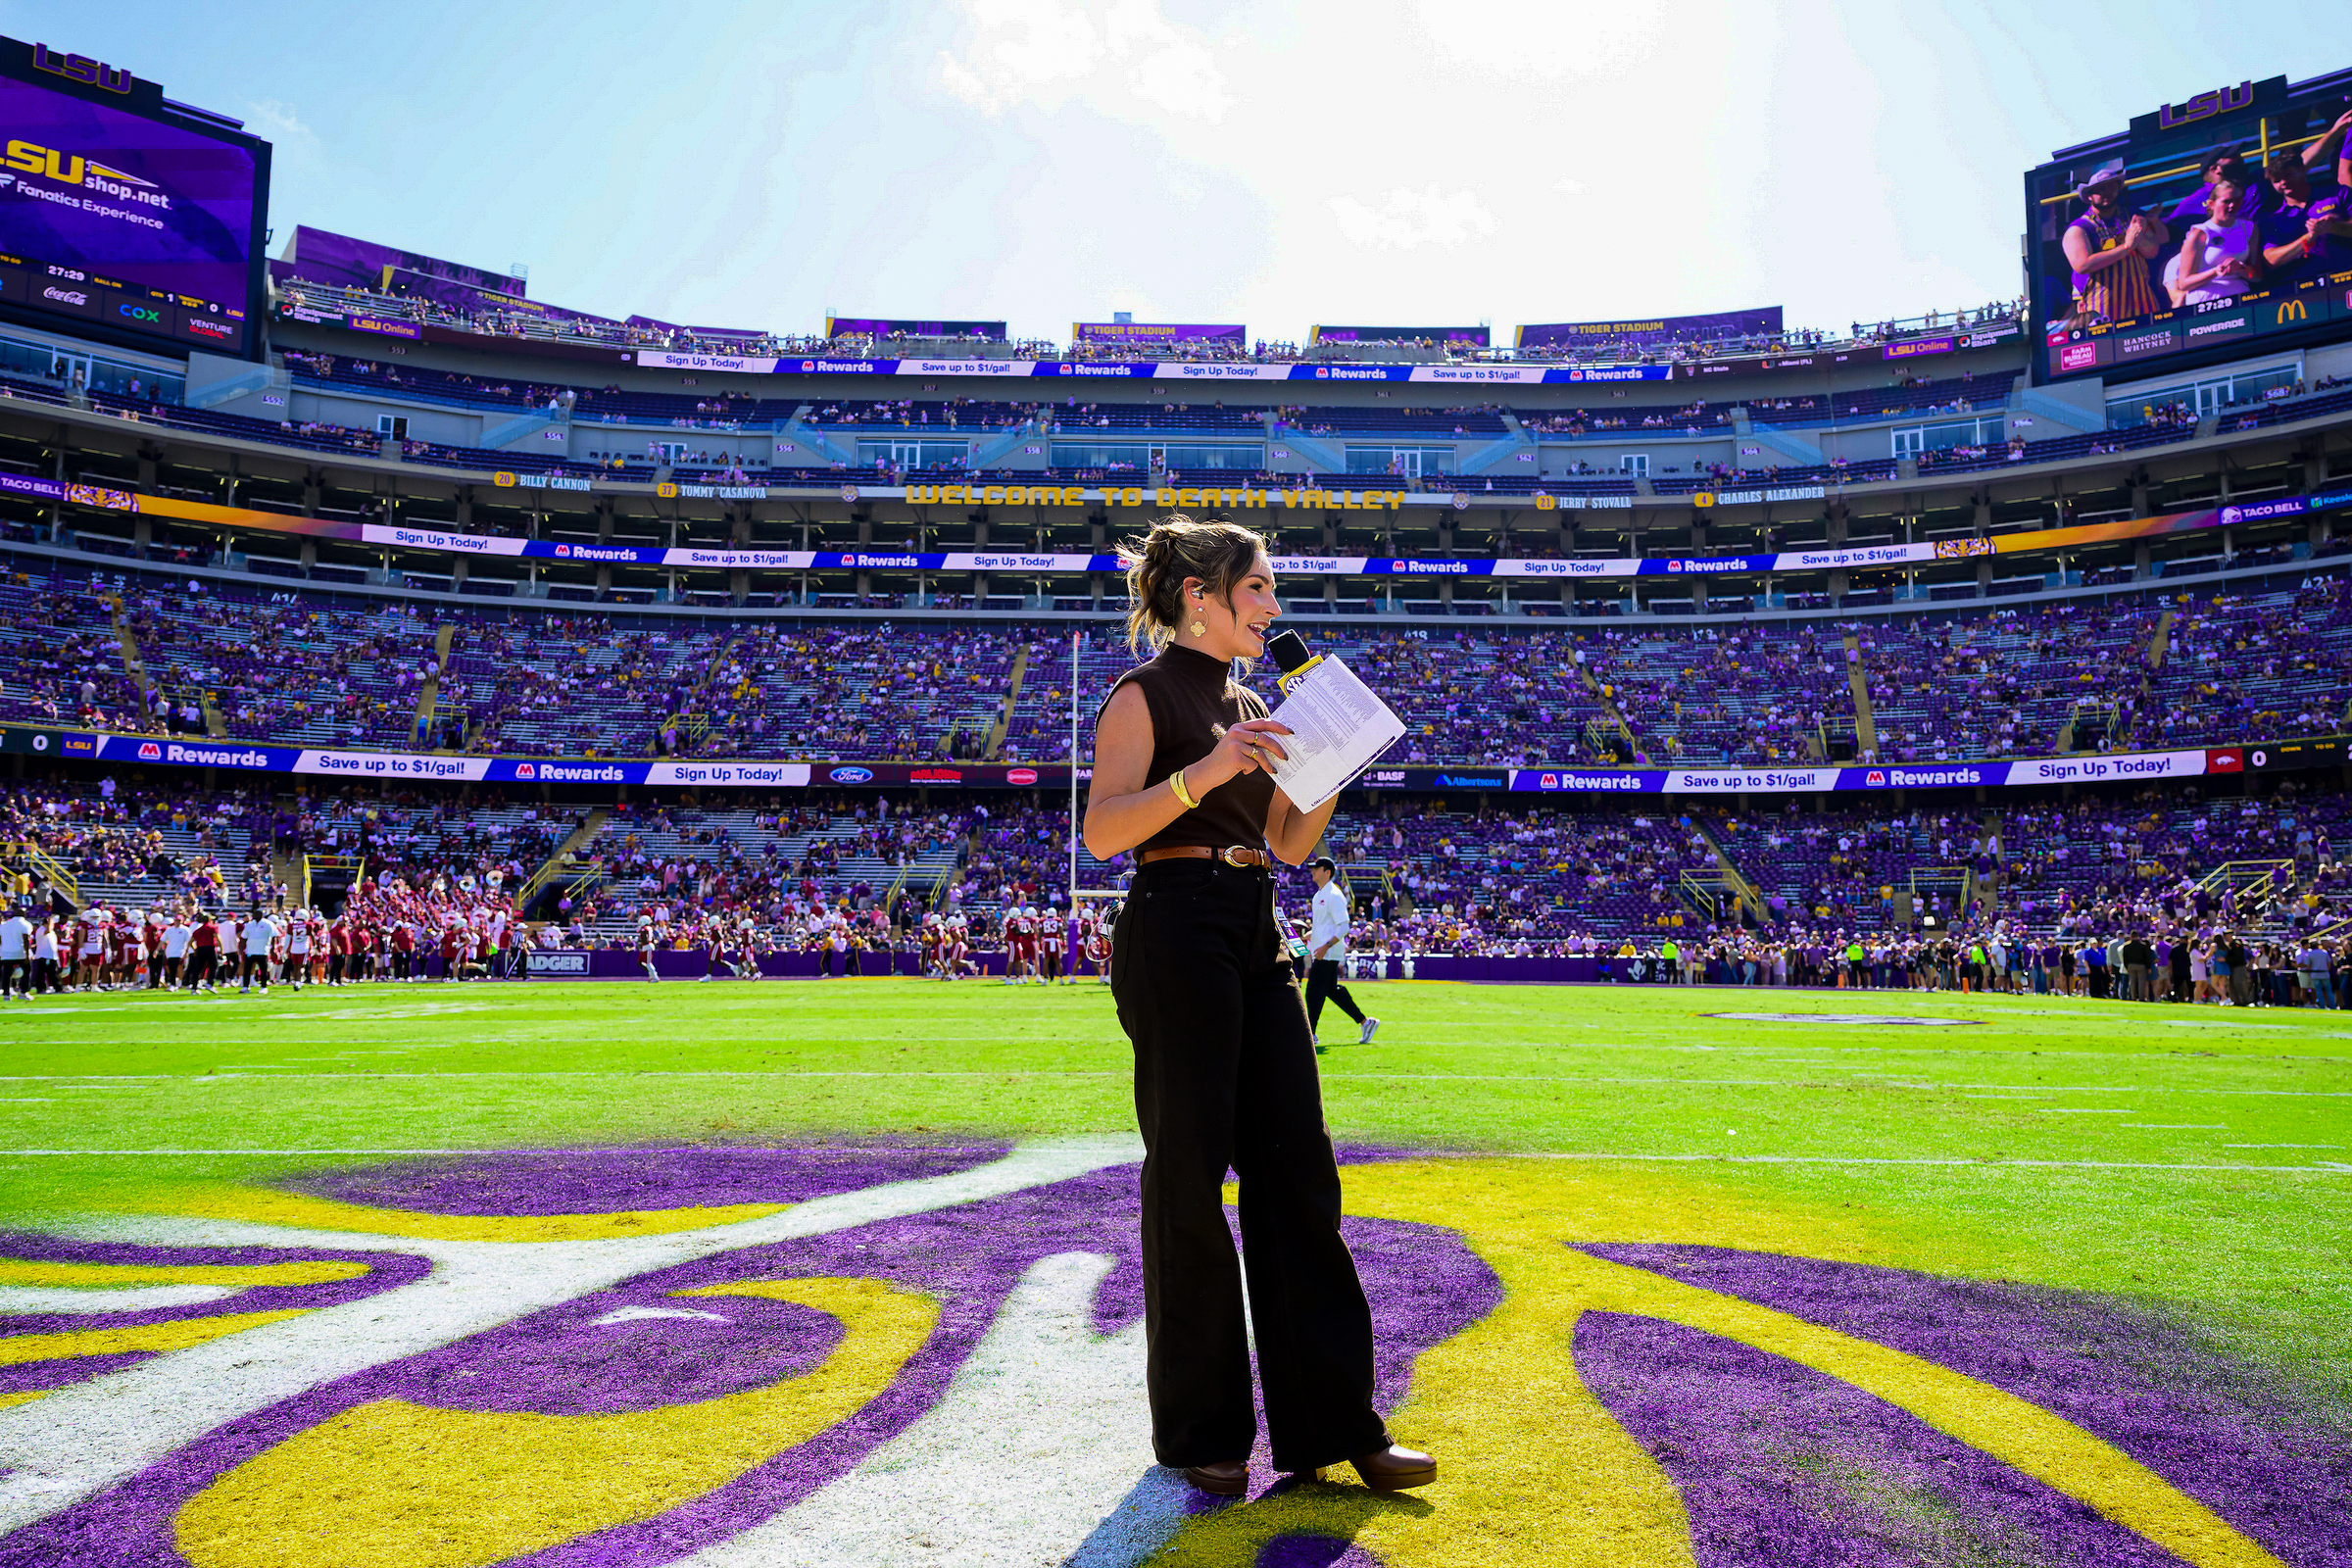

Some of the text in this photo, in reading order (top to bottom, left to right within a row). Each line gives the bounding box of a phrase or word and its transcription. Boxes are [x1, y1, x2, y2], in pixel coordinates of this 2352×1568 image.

[32, 42, 132, 95] LSU
[2159, 79, 2253, 130] LSU
[0, 139, 84, 185] SU
[17, 180, 80, 209] Fanatics
[84, 175, 171, 210] shop.net
[81, 199, 165, 231] Experience
[48, 265, 85, 282] 27:29
[2317, 277, 2325, 287] 1
[167, 293, 174, 303] 1
[483, 292, 545, 312] TIGER STADIUM
[2197, 297, 2233, 313] 27:29
[119, 303, 160, 323] COX
[209, 303, 220, 314] 0
[294, 305, 344, 321] Equipment
[293, 313, 321, 324] Share
[188, 324, 225, 340] GLOBAL
[189, 318, 233, 335] VENTURE
[353, 318, 416, 336] LSU Online
[1094, 325, 1176, 335] TIGER STADIUM
[1579, 321, 1664, 334] TIGER STADIUM
[1971, 326, 2019, 341] Equipment
[2188, 318, 2245, 337] POWERADE
[1971, 337, 1997, 348] Share
[2072, 330, 2082, 340] 0
[2123, 330, 2172, 347] HANCOCK
[1888, 340, 1949, 357] LSU Online
[2123, 336, 2172, 354] WHITNEY
[665, 355, 744, 369] Sign Up Today!
[817, 361, 874, 373] Rewards
[921, 363, 1011, 374] Save up to $1/gal!
[1075, 365, 1131, 375] Rewards
[1183, 366, 1258, 377] Sign Up Today!
[1331, 368, 1387, 379] Rewards
[1433, 369, 1521, 381] Save up to $1/gal!
[1586, 368, 1643, 380] Rewards
[1, 476, 63, 496] TACO BELL
[499, 474, 591, 491] 20 BILLY CANNON
[662, 485, 766, 499] 37 TOMMY CASANOVA
[906, 485, 1405, 510] WELCOME TO DEATH VALLEY
[1700, 487, 1825, 505] 4 CHARLES ALEXANDER
[1540, 496, 1632, 509] 21 JERRY STOVALL
[2242, 501, 2303, 518] TACO BELL
[395, 530, 488, 550] Sign Up Today!
[572, 546, 638, 562] Rewards
[691, 553, 789, 565] Save up to $1/gal!
[858, 555, 918, 567] Rewards
[1801, 548, 1907, 565] Save up to $1/gal!
[974, 556, 1054, 568] Sign Up Today!
[1289, 560, 1299, 569] to
[1301, 560, 1338, 571] $1/gal!
[1408, 561, 1468, 573] Rewards
[1524, 563, 1605, 574] Sign Up Today!
[1685, 558, 1747, 571] Rewards
[32, 734, 49, 751] 0
[66, 741, 92, 750] LSU
[167, 745, 268, 767] Rewards
[2251, 751, 2267, 766] 0
[319, 756, 466, 775] Save up to $1/gal!
[540, 764, 624, 781] Rewards
[2039, 758, 2172, 779] Sign Up Today!
[675, 767, 783, 781] Sign Up Today!
[837, 768, 864, 781] Ford
[910, 769, 931, 780] PAPA
[1076, 769, 1094, 778] FAR
[1377, 771, 1405, 781] BASF
[1684, 773, 1815, 789] Save up to $1/gal!
[1890, 768, 1981, 785] Rewards
[1451, 777, 1502, 787] Albertsons
[1562, 774, 1642, 790] Rewards
[1043, 920, 1058, 933] 83
[525, 956, 585, 970] ADGER
